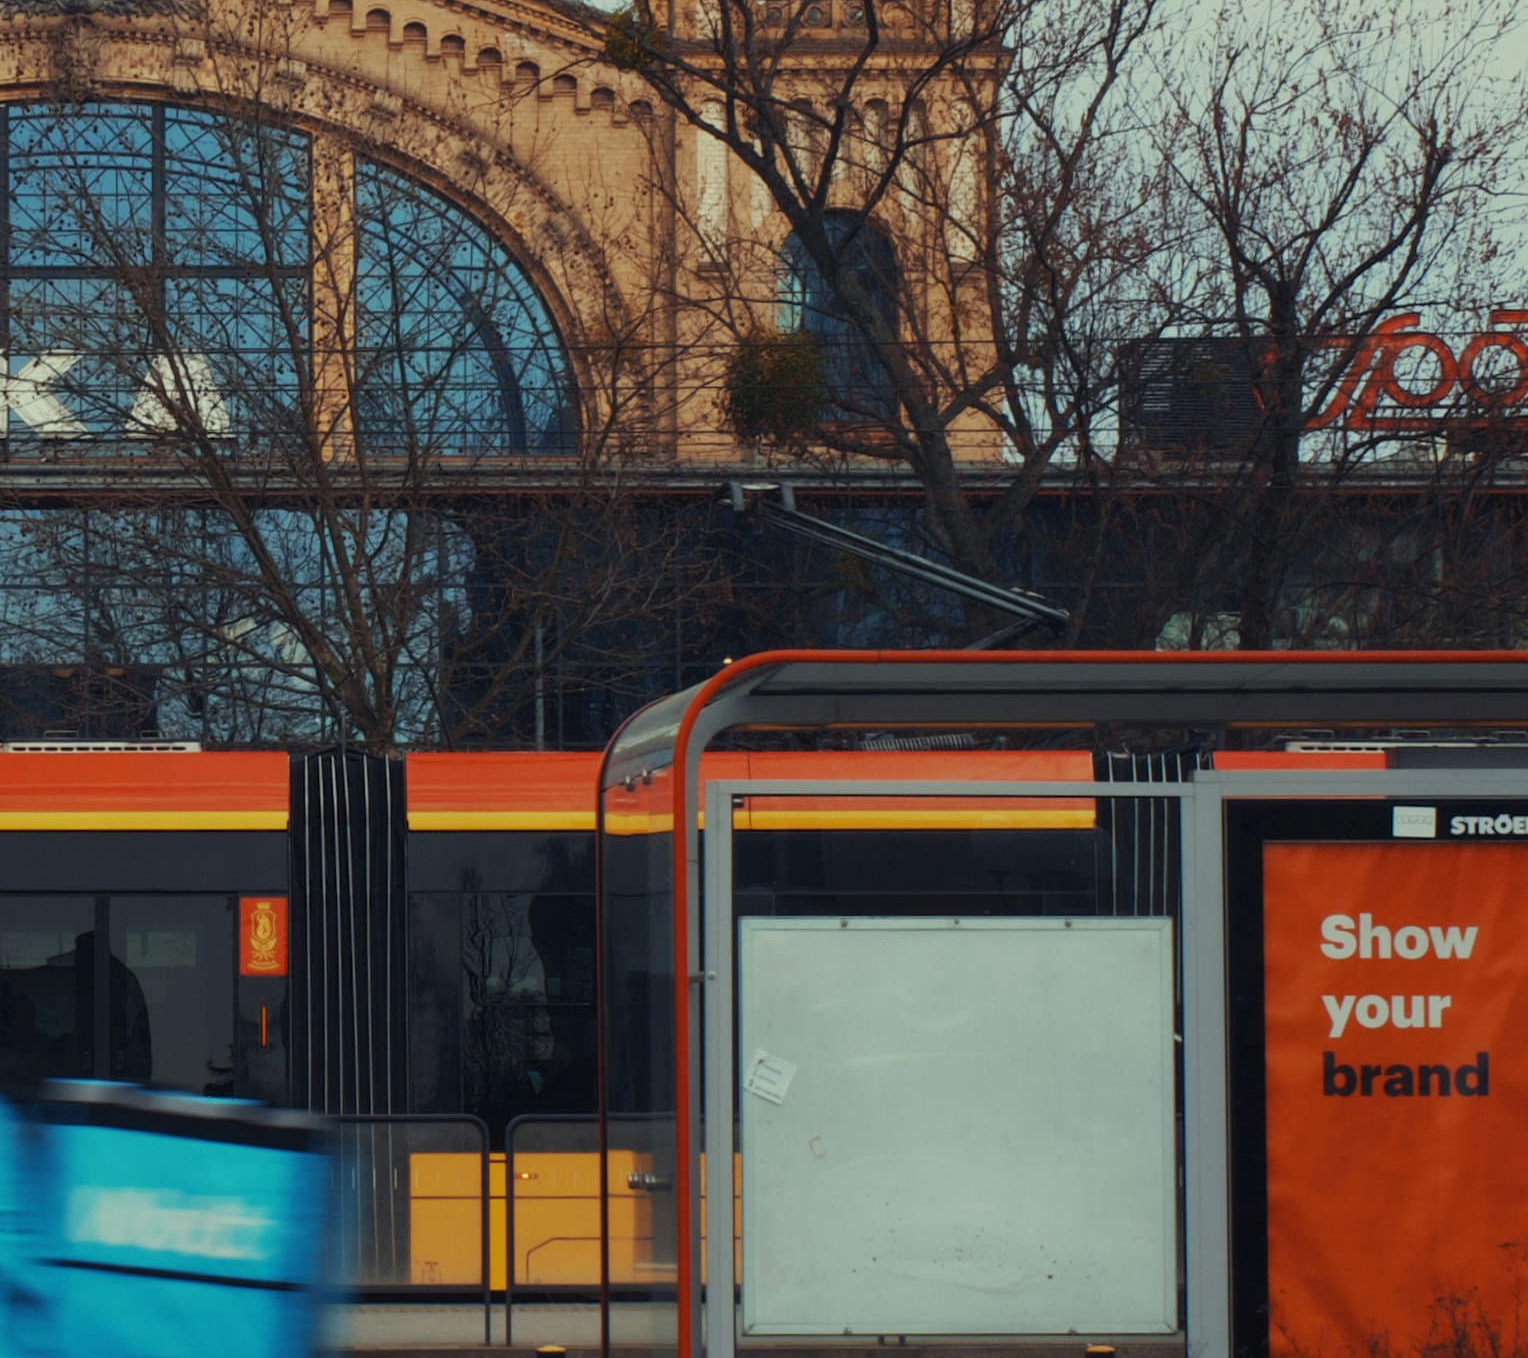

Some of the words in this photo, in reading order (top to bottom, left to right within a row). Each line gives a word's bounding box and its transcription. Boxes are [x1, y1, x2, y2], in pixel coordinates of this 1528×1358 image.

[1320, 912, 1480, 960] Show
[1321, 994, 1452, 1038] your
[1322, 1051, 1490, 1096] brand
